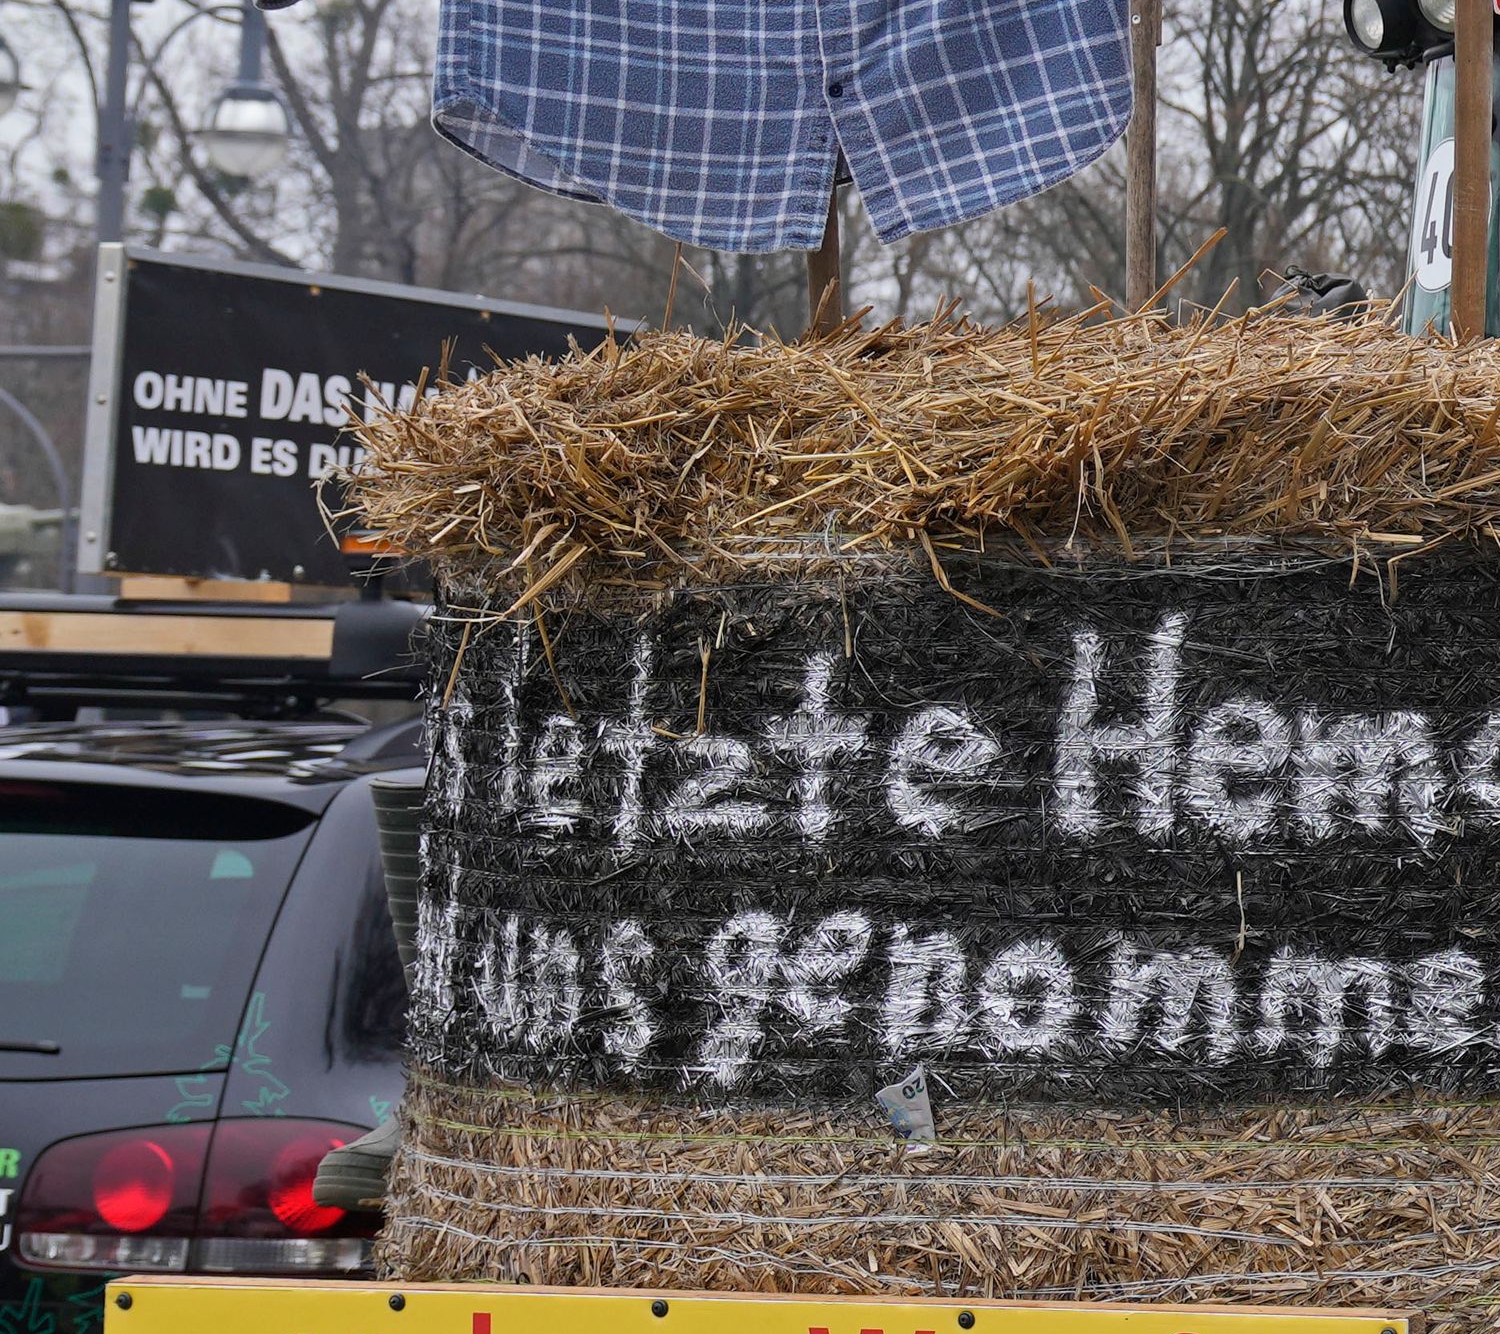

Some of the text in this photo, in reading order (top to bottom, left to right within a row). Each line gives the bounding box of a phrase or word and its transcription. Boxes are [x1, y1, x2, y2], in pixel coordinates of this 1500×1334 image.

[134, 371, 249, 418] OHNE
[260, 367, 353, 430] DAS
[131, 426, 241, 471] WIRD
[251, 437, 299, 477] ES
